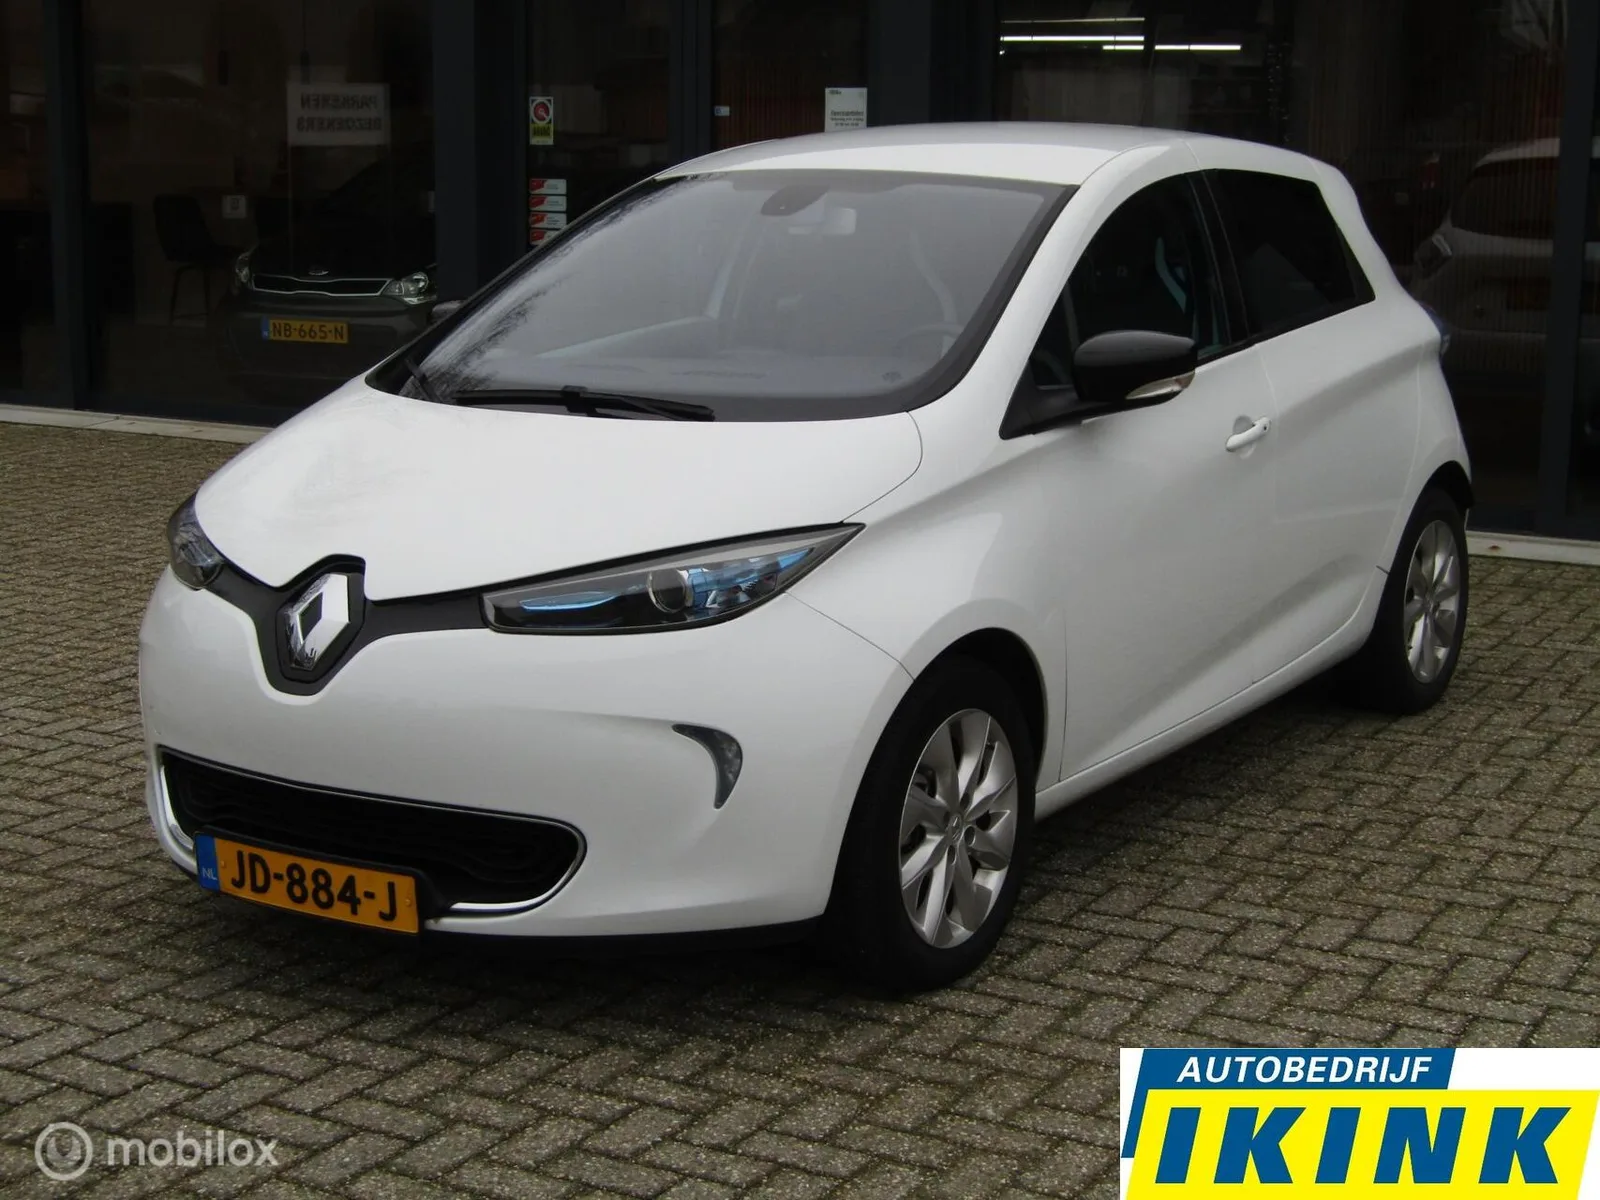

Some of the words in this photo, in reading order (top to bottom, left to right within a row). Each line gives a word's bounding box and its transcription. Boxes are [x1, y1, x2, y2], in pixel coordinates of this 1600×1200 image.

[272, 321, 344, 341] NB-665-N
[201, 866, 218, 881] NL
[231, 850, 398, 922] JD-884-J
